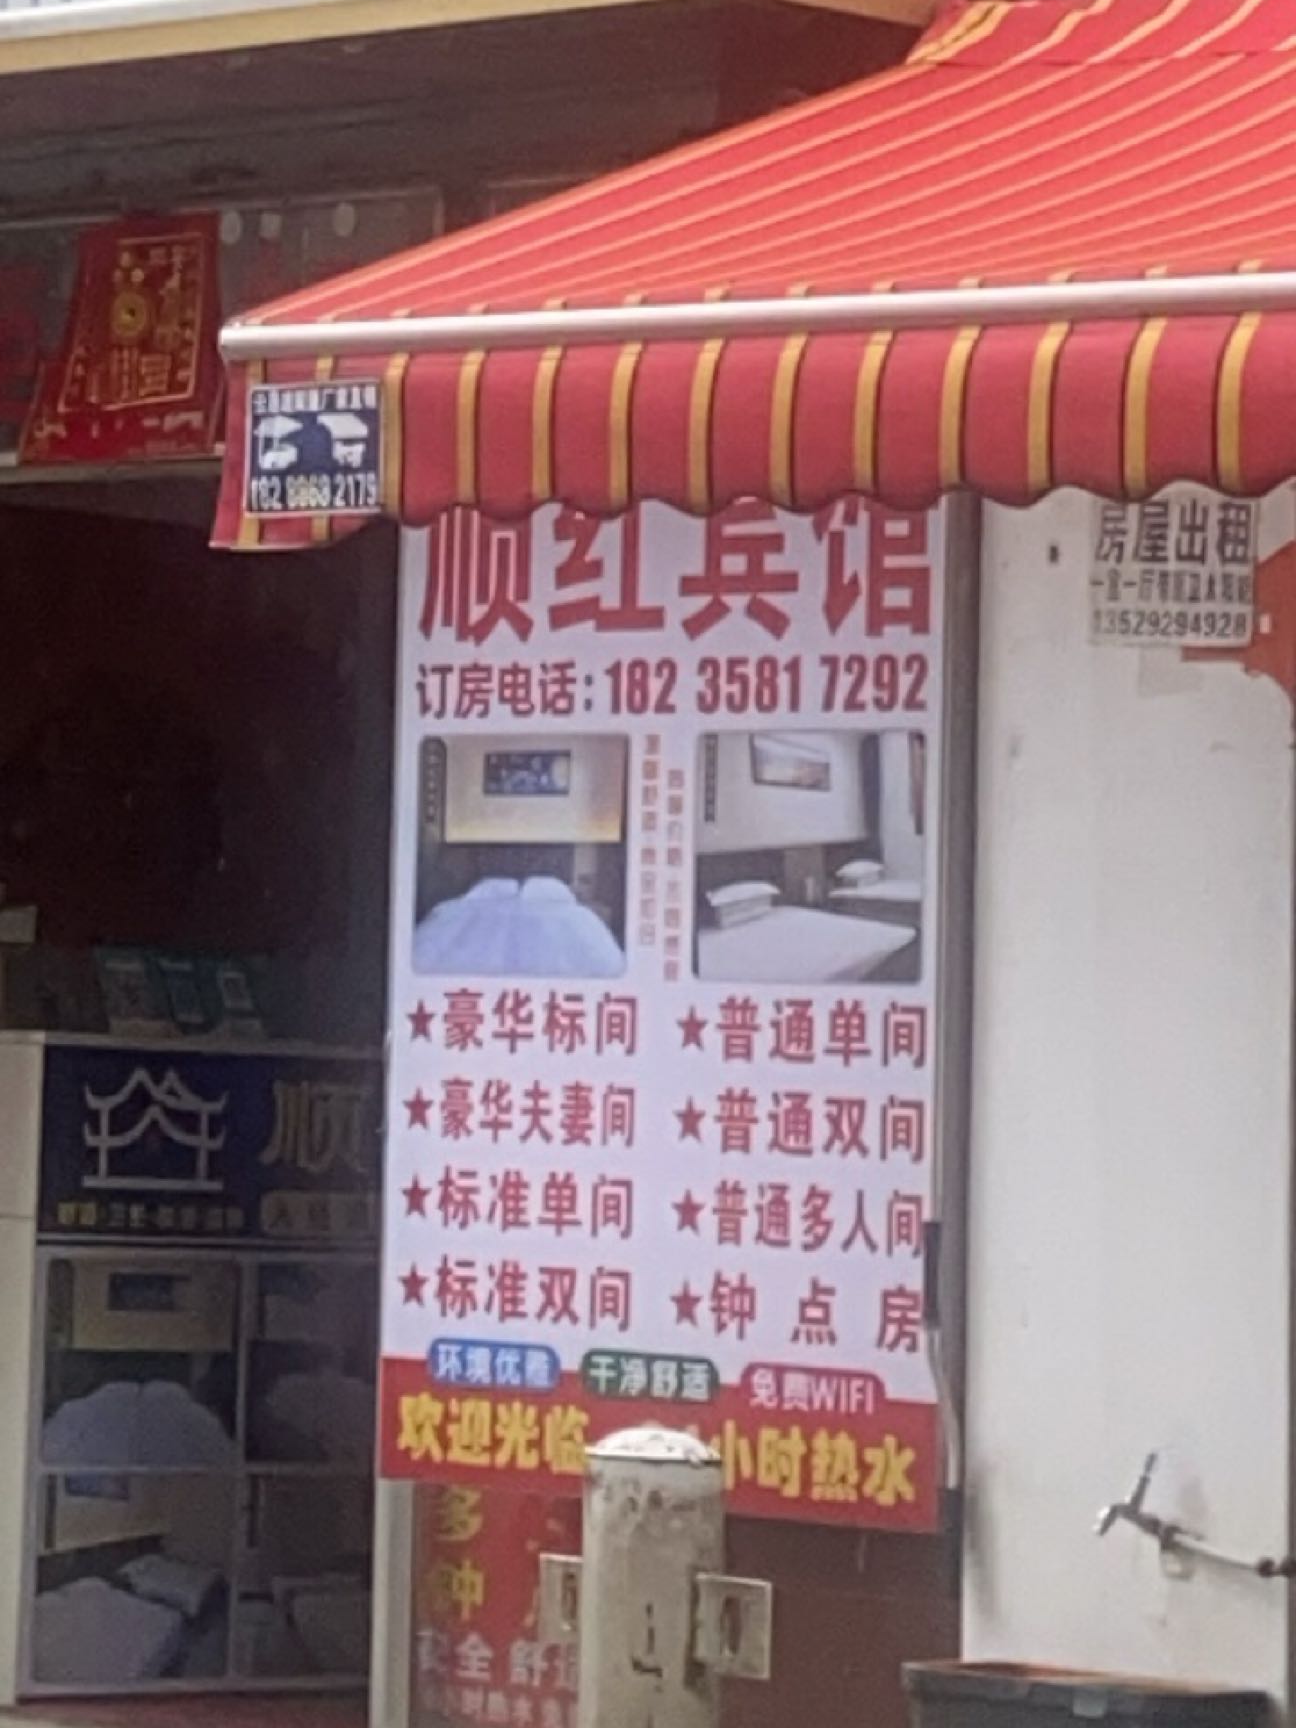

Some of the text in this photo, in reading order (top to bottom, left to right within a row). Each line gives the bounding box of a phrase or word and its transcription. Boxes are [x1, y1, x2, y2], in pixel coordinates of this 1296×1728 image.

[418, 494, 932, 646] 顺红宾馆
[696, 655, 802, 715] 3581
[819, 652, 930, 714] 7292
[442, 988, 639, 1056] 豪华标间
[714, 994, 929, 1069] 普通单间
[439, 1076, 637, 1148] 豪华夫妻间
[713, 1086, 926, 1164] 普通双间
[436, 1164, 634, 1240] 标准单间
[711, 1179, 926, 1259] 普通多人间
[434, 1253, 632, 1334] 标准双间
[708, 1269, 926, 1354] 钟点房
[587, 1351, 711, 1398] 干净舒适
[749, 1366, 876, 1415] 免费WIFI
[397, 1392, 917, 1508] 欢迎光临 小时热水
